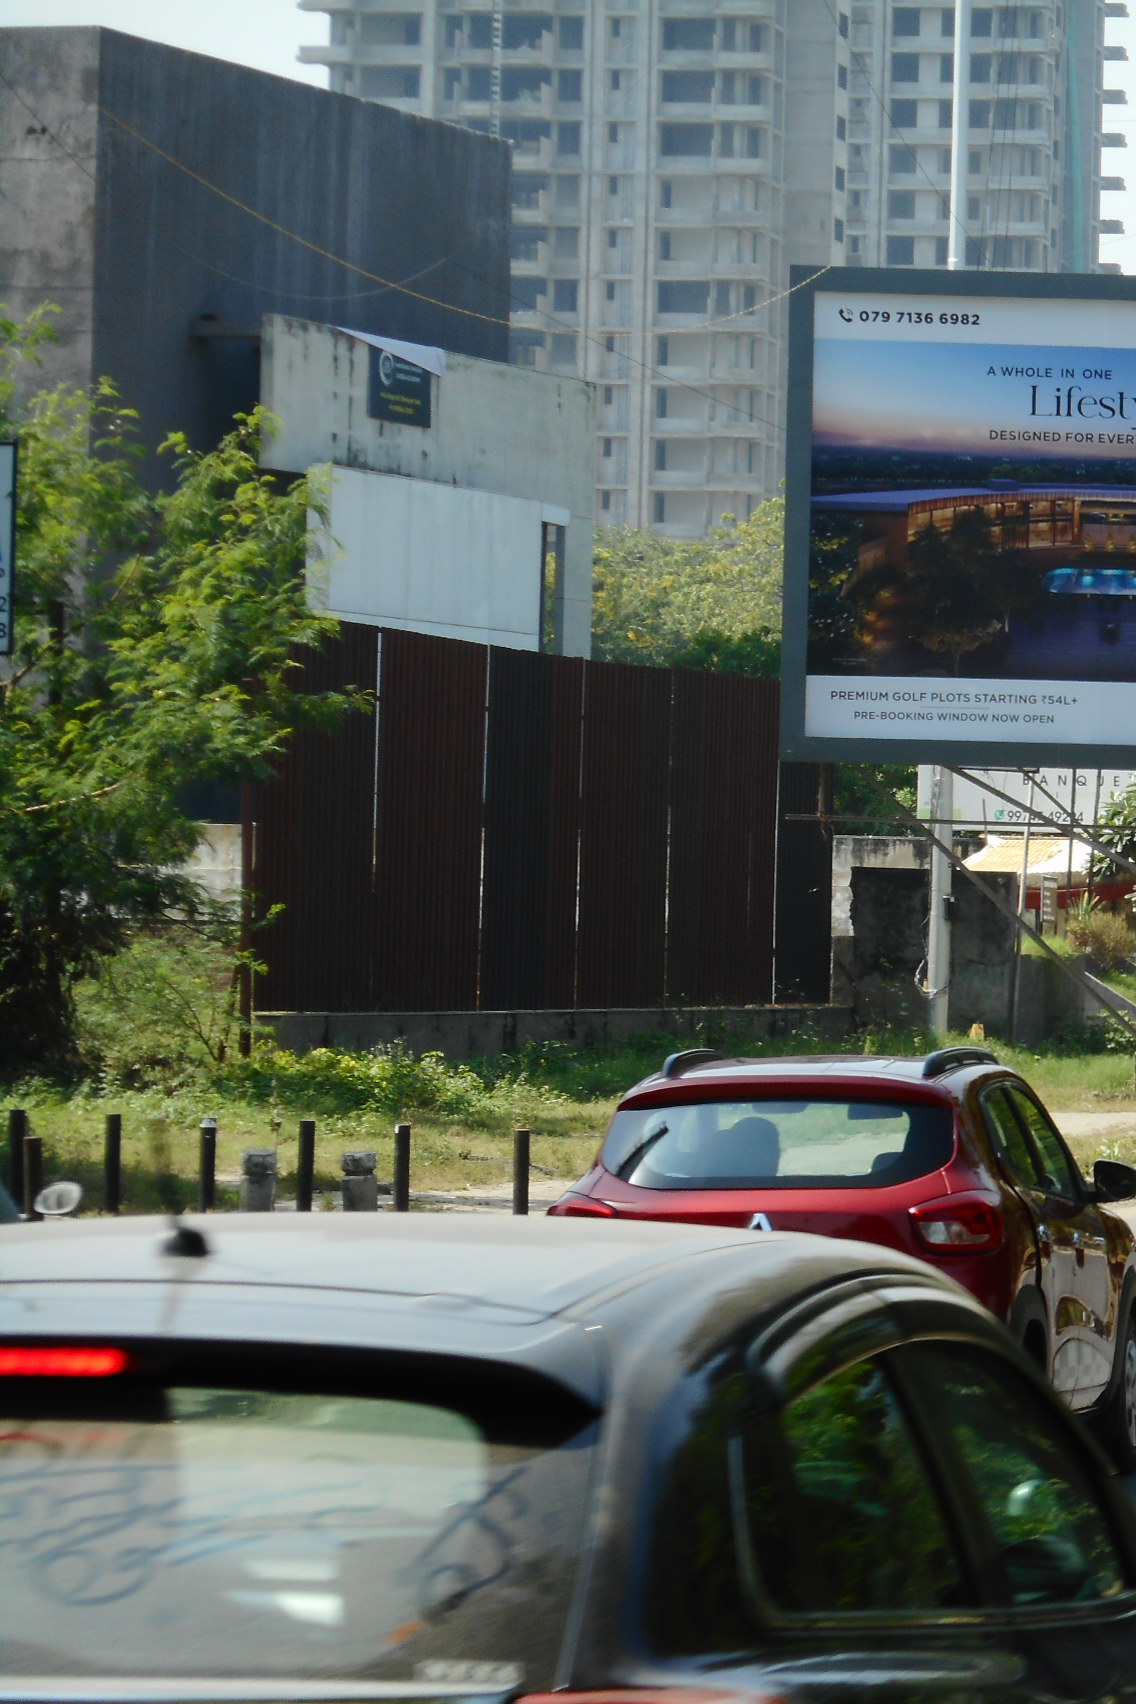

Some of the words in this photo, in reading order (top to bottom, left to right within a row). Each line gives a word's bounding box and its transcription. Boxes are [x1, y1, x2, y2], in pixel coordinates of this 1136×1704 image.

[859, 310, 891, 323] 079
[896, 311, 934, 324] 7136
[939, 313, 980, 325] 6982
[987, 366, 996, 377] A
[1000, 367, 1053, 378] WHOLE
[1060, 368, 1075, 379] IN
[1082, 369, 1113, 380] ONE
[989, 430, 1061, 442] DESIGNED
[1065, 432, 1094, 443] FOR
[830, 690, 889, 702] PREMIUM
[892, 692, 927, 702] GOLF
[930, 692, 971, 704] PLOTS
[974, 693, 1037, 705] STARTING
[853, 711, 934, 722] PRE-BOOKING
[936, 712, 989, 723] WINDOW
[991, 713, 1020, 724] NOW
[1023, 714, 1055, 724] OPEN
[1022, 774, 1136, 788] BANQUE
